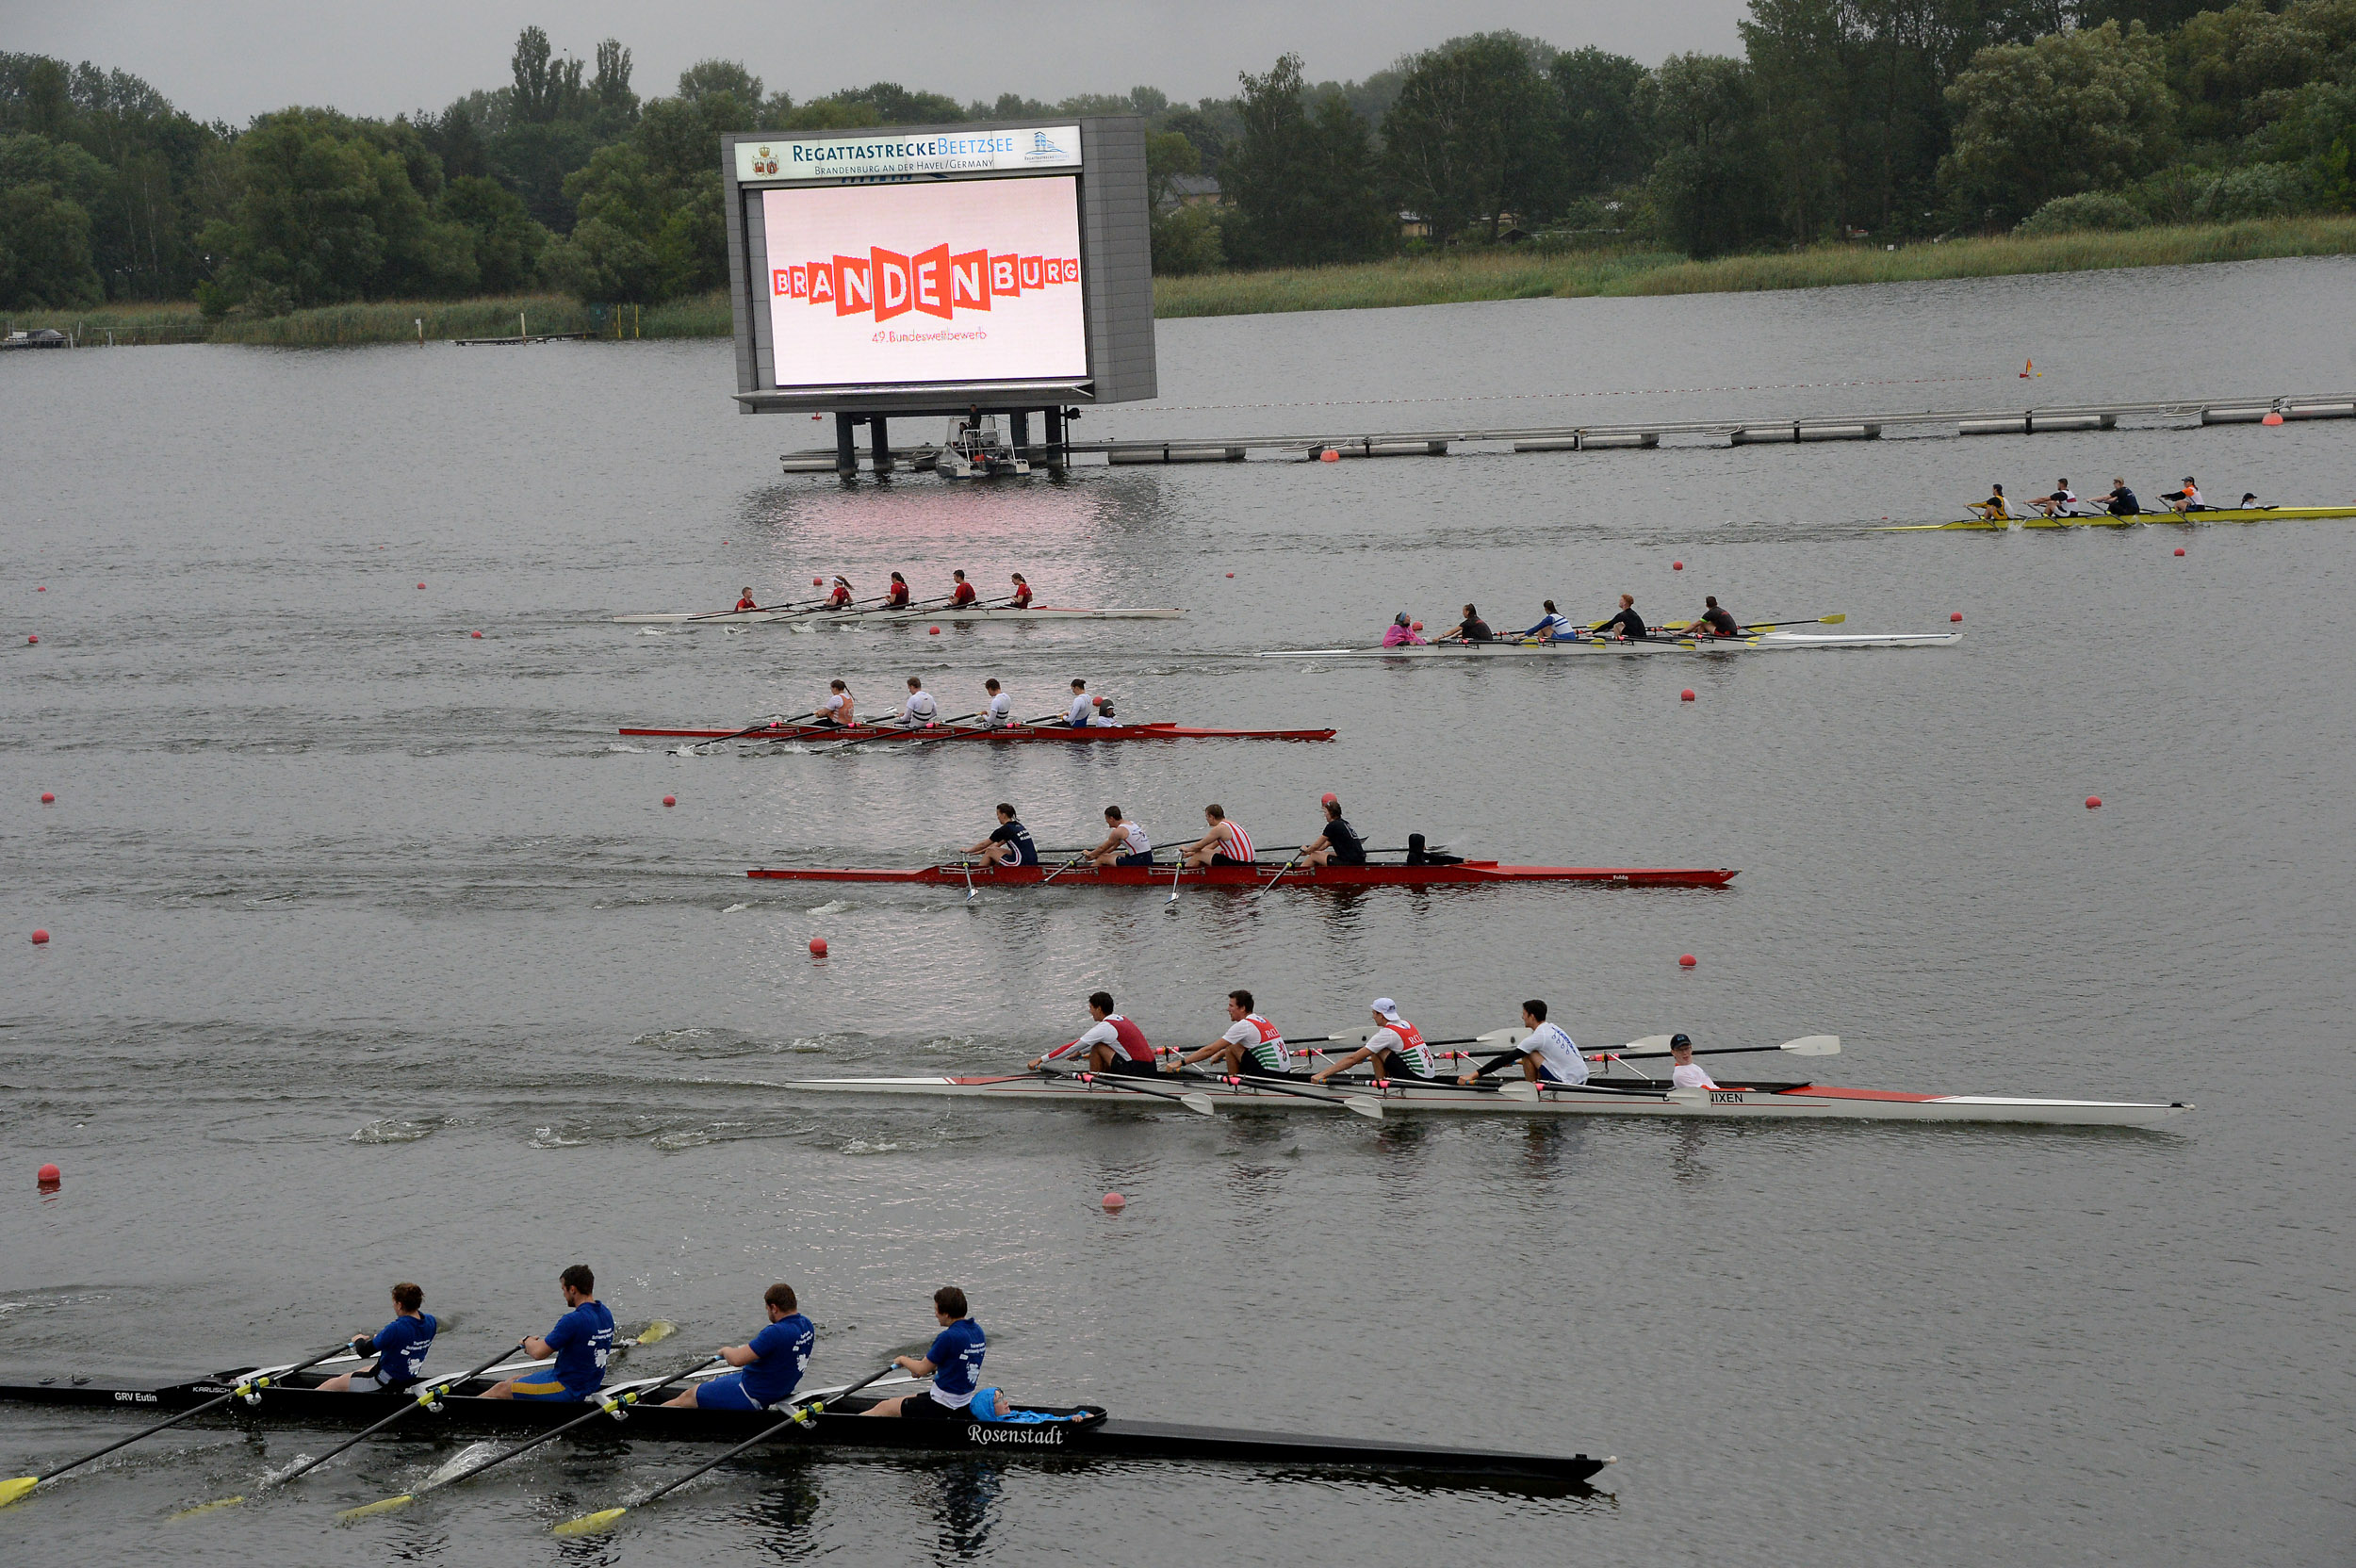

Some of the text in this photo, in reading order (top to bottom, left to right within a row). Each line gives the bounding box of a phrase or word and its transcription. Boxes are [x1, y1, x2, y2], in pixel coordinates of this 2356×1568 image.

[814, 165, 880, 175] BRANDENBURG
[882, 164, 895, 172] AN
[897, 163, 914, 172] DER
[775, 257, 1078, 310] BRANDENBURG
[114, 1392, 157, 1402] GRV Eutin
[968, 1424, 1064, 1445] Rosenstadt
